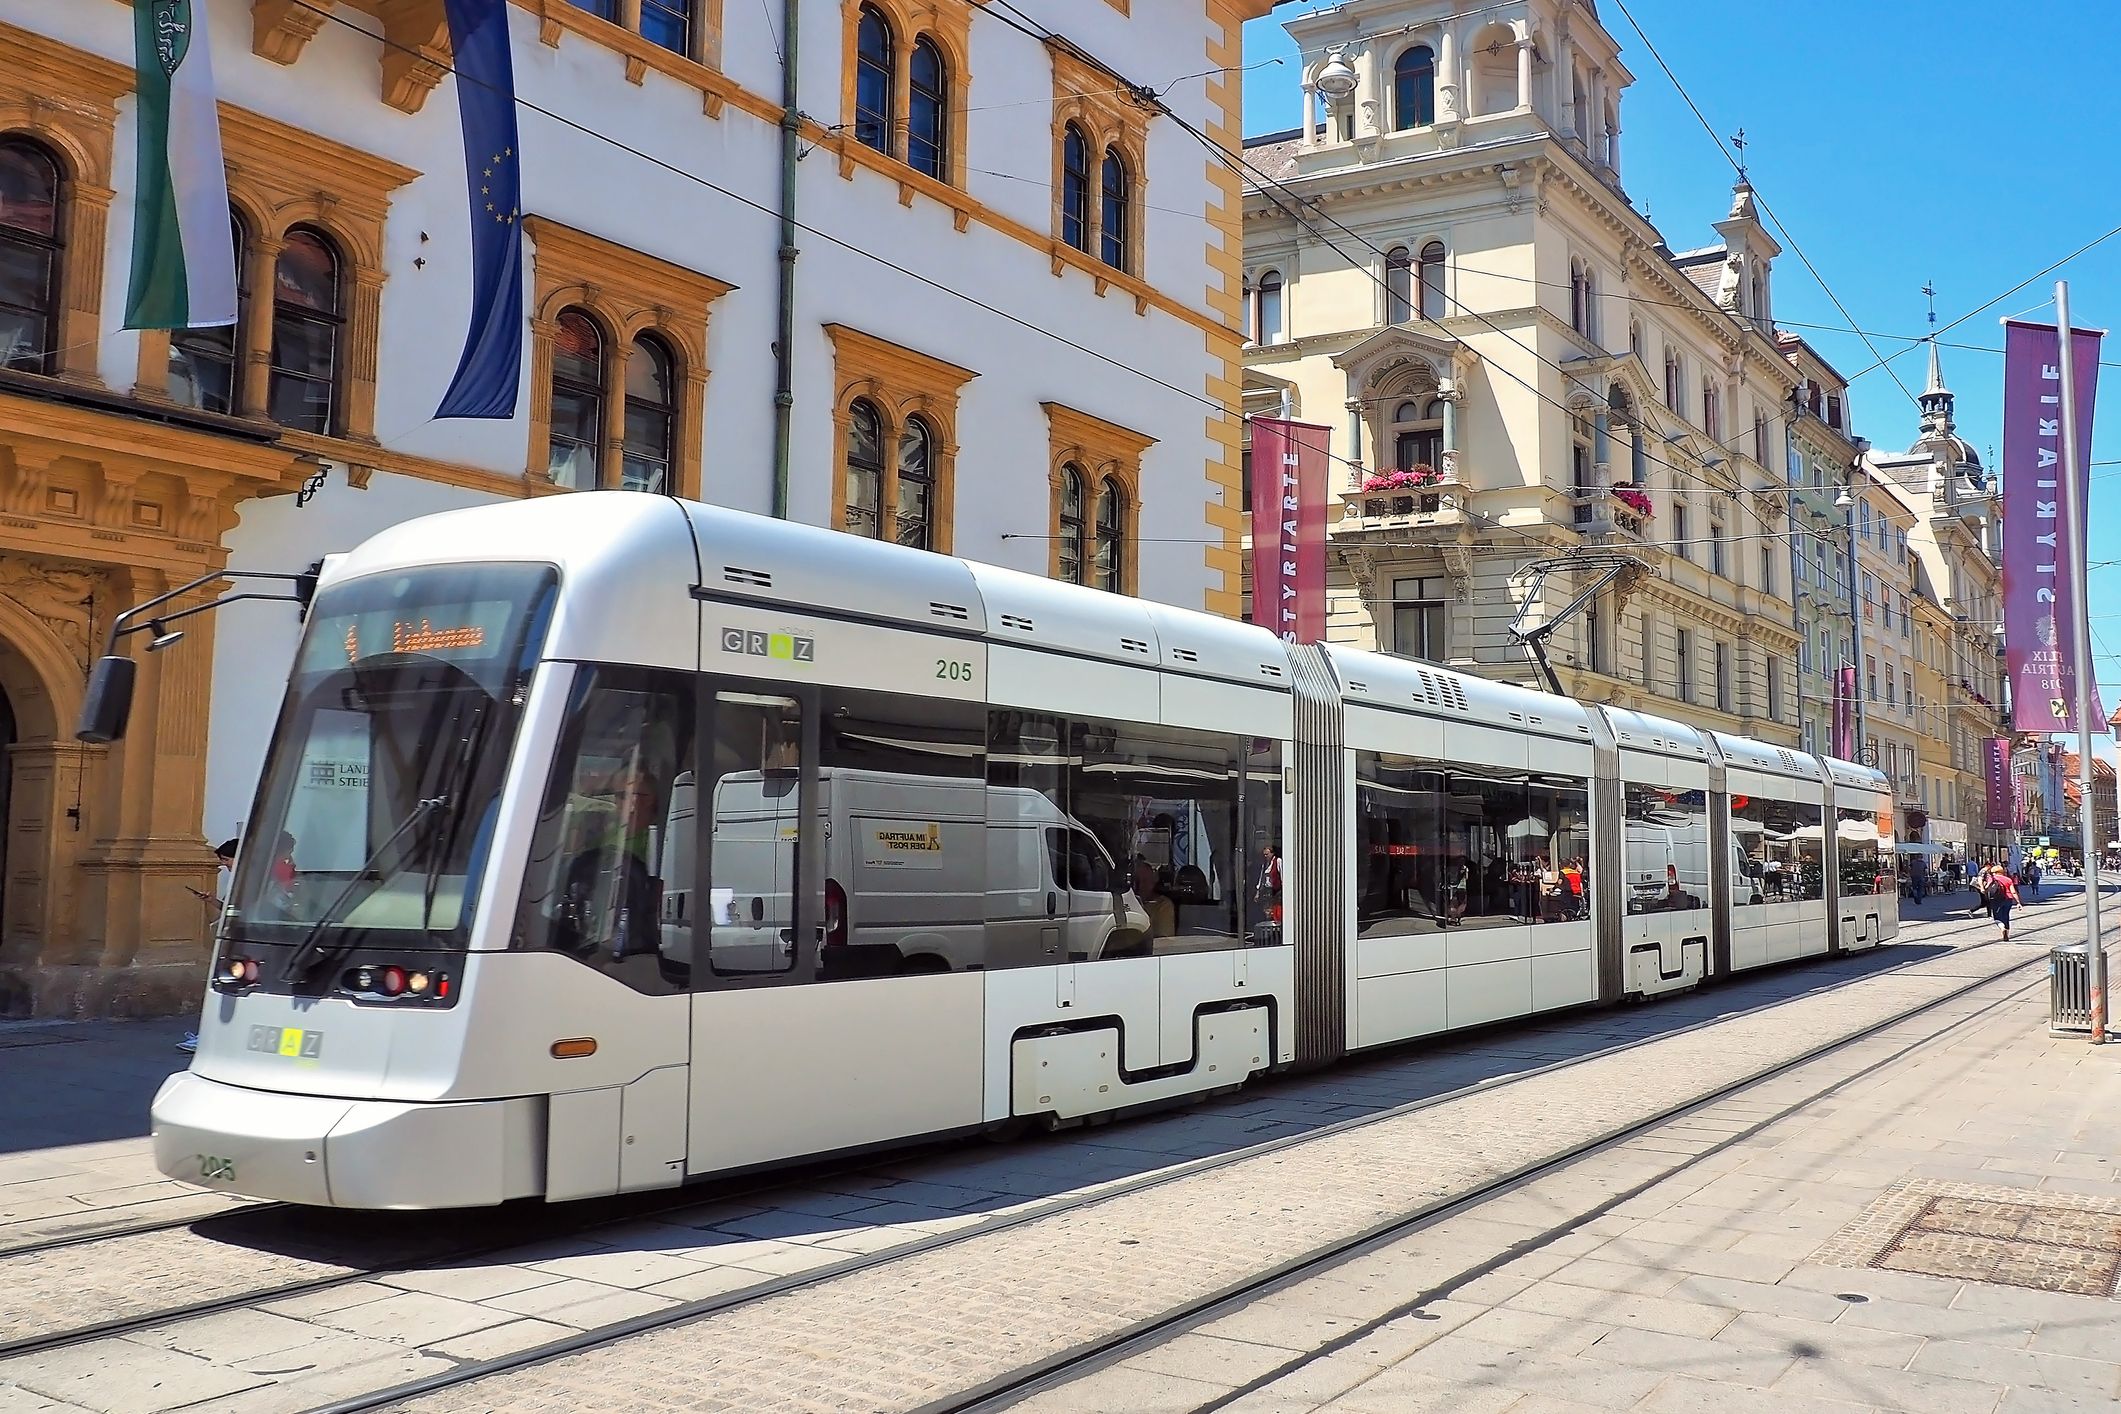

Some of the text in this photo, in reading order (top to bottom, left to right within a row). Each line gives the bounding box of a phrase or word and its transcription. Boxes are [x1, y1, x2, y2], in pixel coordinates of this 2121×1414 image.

[1282, 453, 1299, 645] STYRIARTE
[723, 628, 814, 662] GRAZ
[936, 659, 972, 681] 205
[248, 1026, 322, 1058] GRAZ
[196, 1153, 236, 1182] 205
